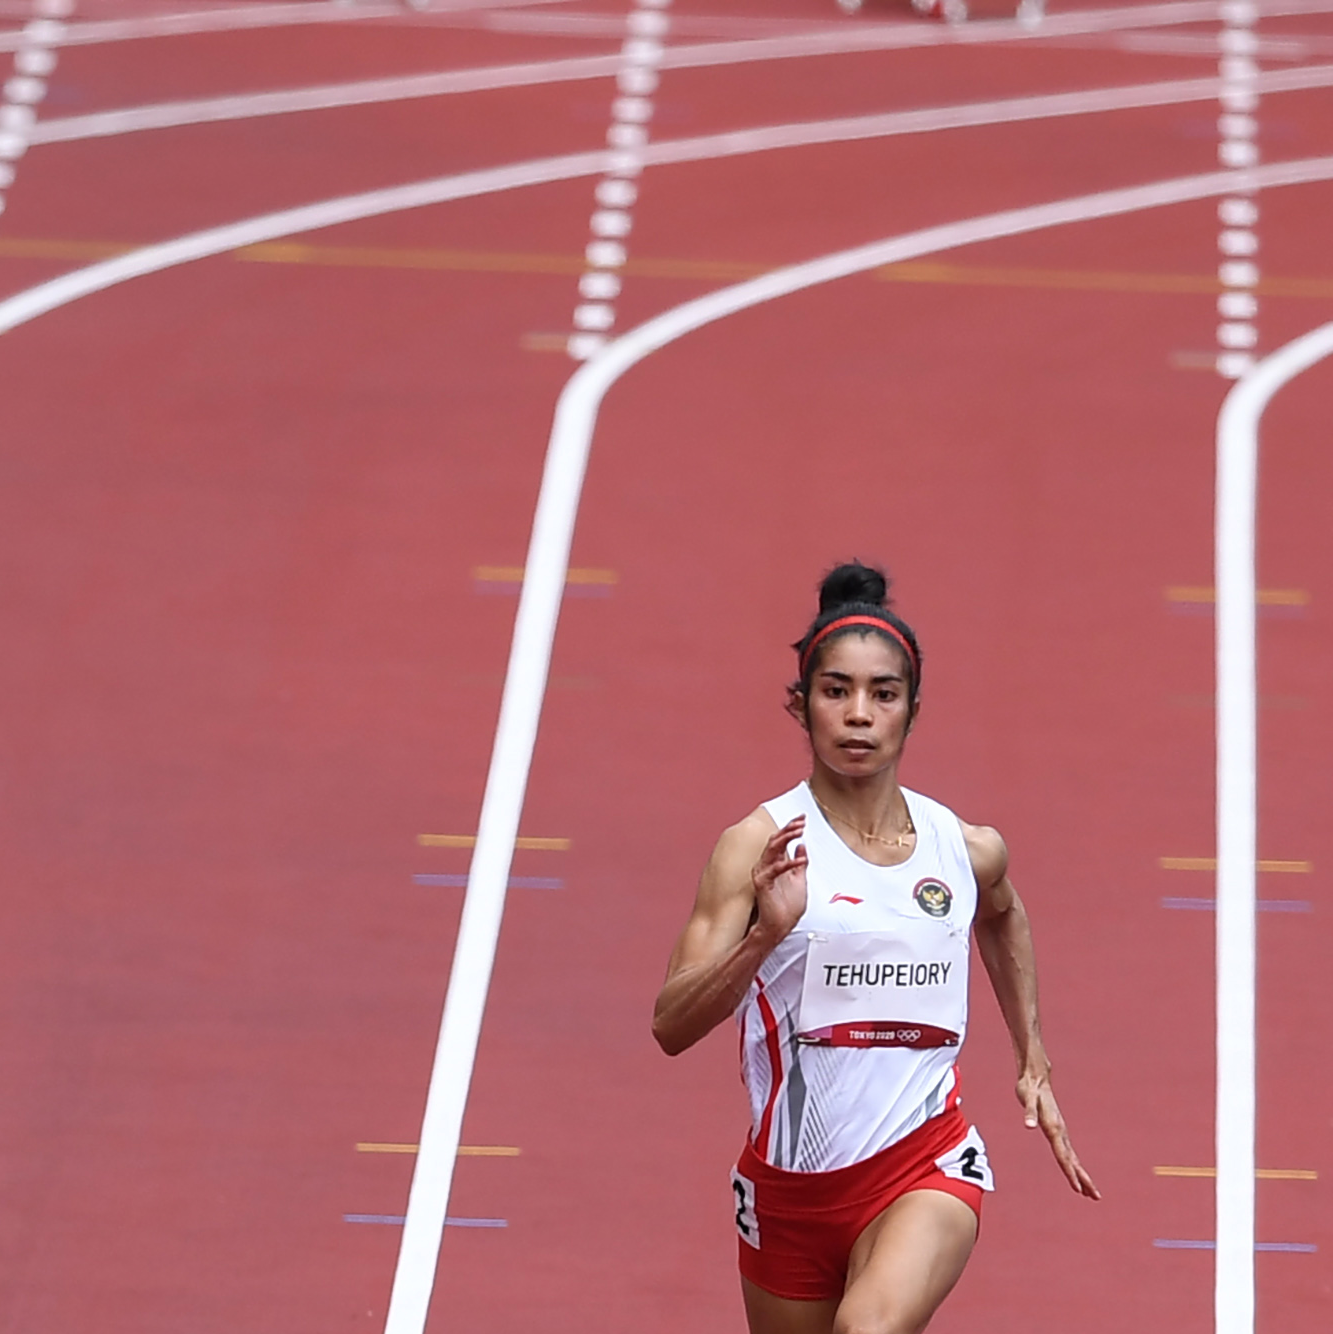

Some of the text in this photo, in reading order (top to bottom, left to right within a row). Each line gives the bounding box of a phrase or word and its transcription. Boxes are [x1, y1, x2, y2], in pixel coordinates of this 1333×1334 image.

[823, 962, 952, 987] TEHUPEIORY
[848, 1030, 875, 1040] TOKYO
[958, 1146, 984, 1181] 2
